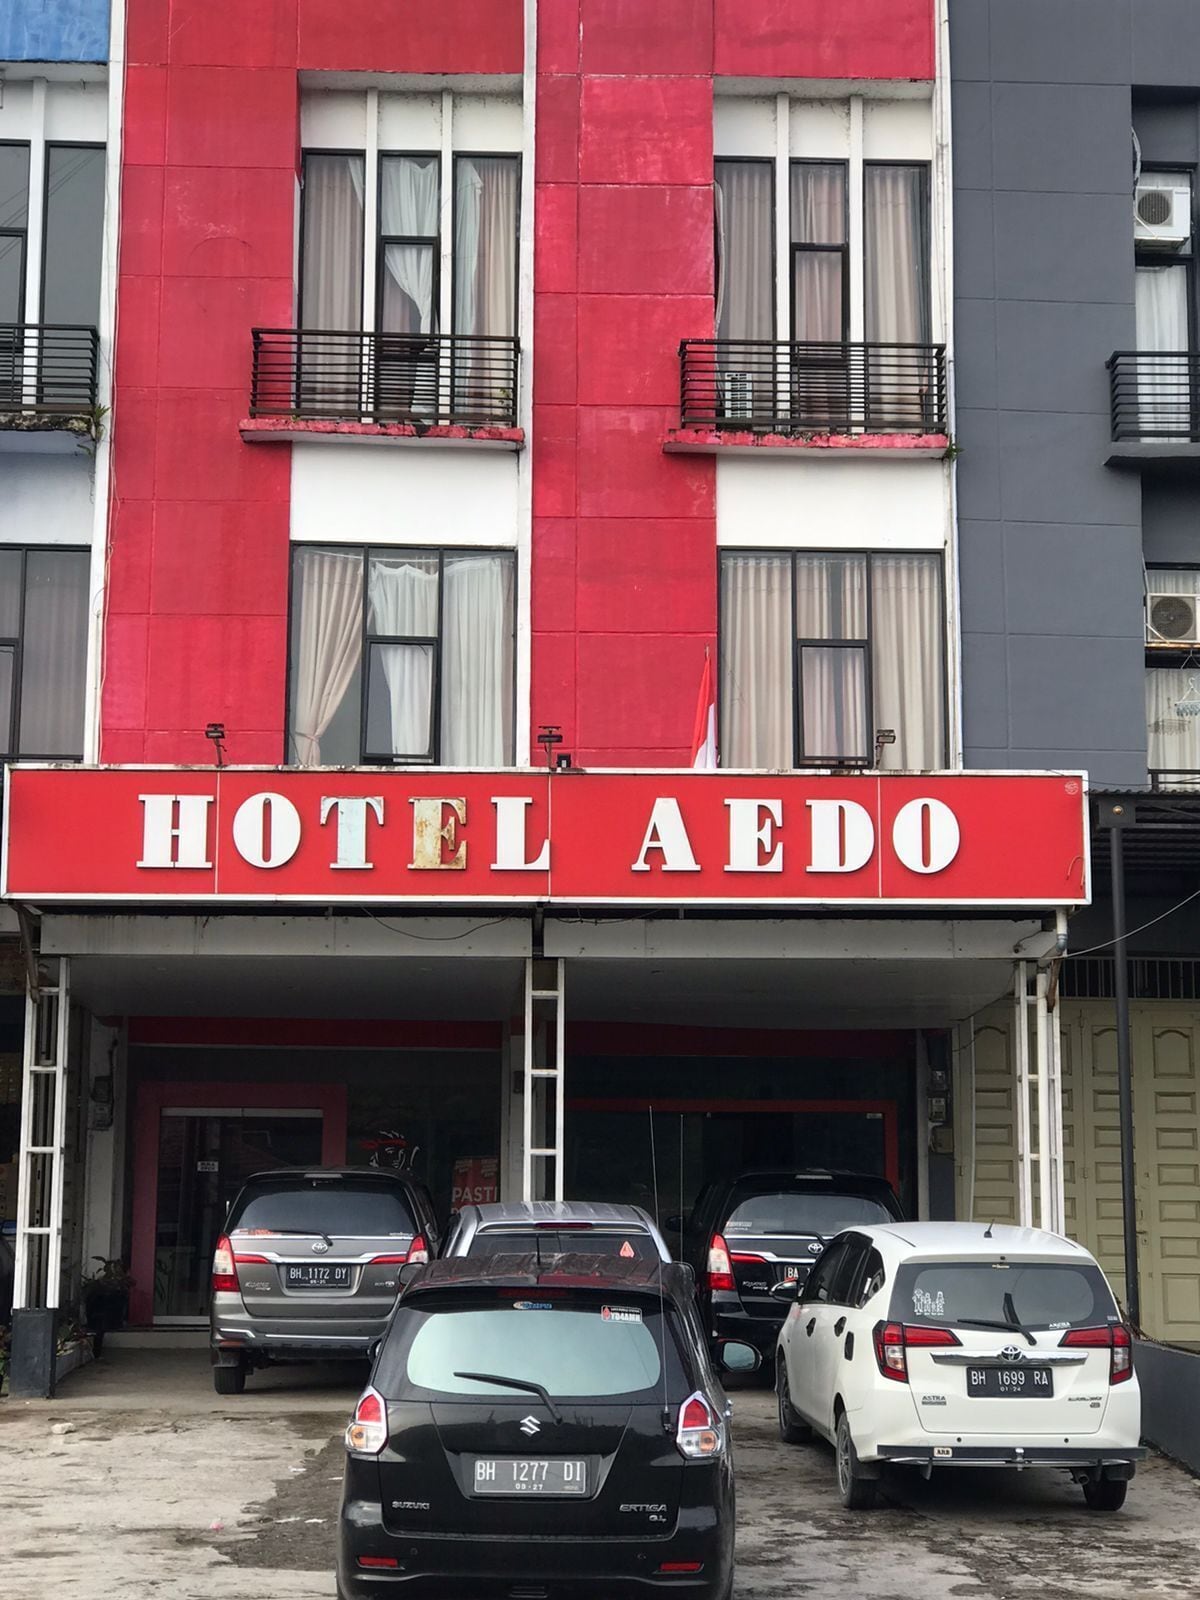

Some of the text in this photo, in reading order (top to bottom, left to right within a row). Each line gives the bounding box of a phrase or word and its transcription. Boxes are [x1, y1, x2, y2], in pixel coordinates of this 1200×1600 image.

[136, 791, 961, 875] HOTEL AEDO
[452, 1186, 497, 1202] PASTI
[290, 1267, 347, 1279] BH 1172 DY
[969, 1370, 1048, 1386] BH 1699 RA
[475, 1461, 580, 1481] BH 1277 DI
[392, 1501, 430, 1510] SUZUKI
[619, 1503, 667, 1512] ERTIGA
